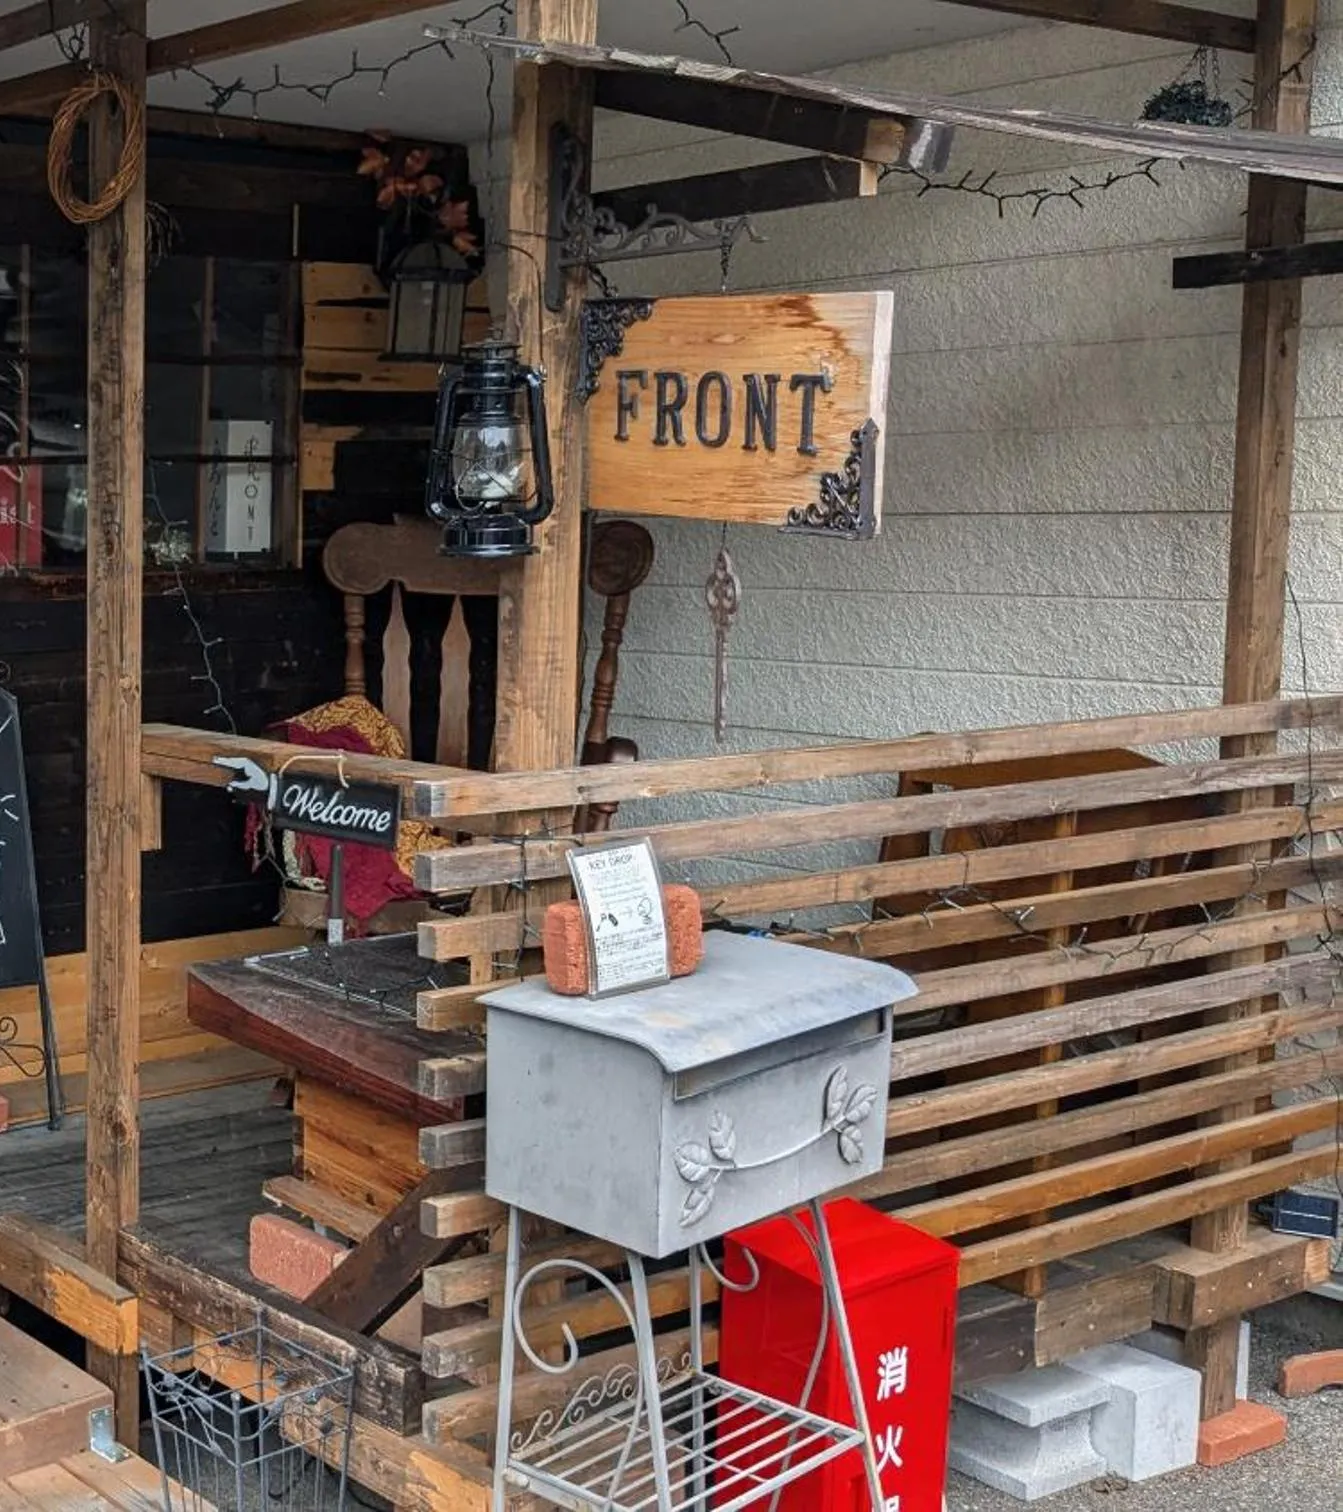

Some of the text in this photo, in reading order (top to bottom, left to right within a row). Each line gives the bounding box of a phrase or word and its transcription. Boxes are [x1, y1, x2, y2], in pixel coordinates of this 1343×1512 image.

[613, 369, 835, 457] FRONT
[282, 783, 392, 832] Welcome
[874, 1345, 909, 1512] 消火
